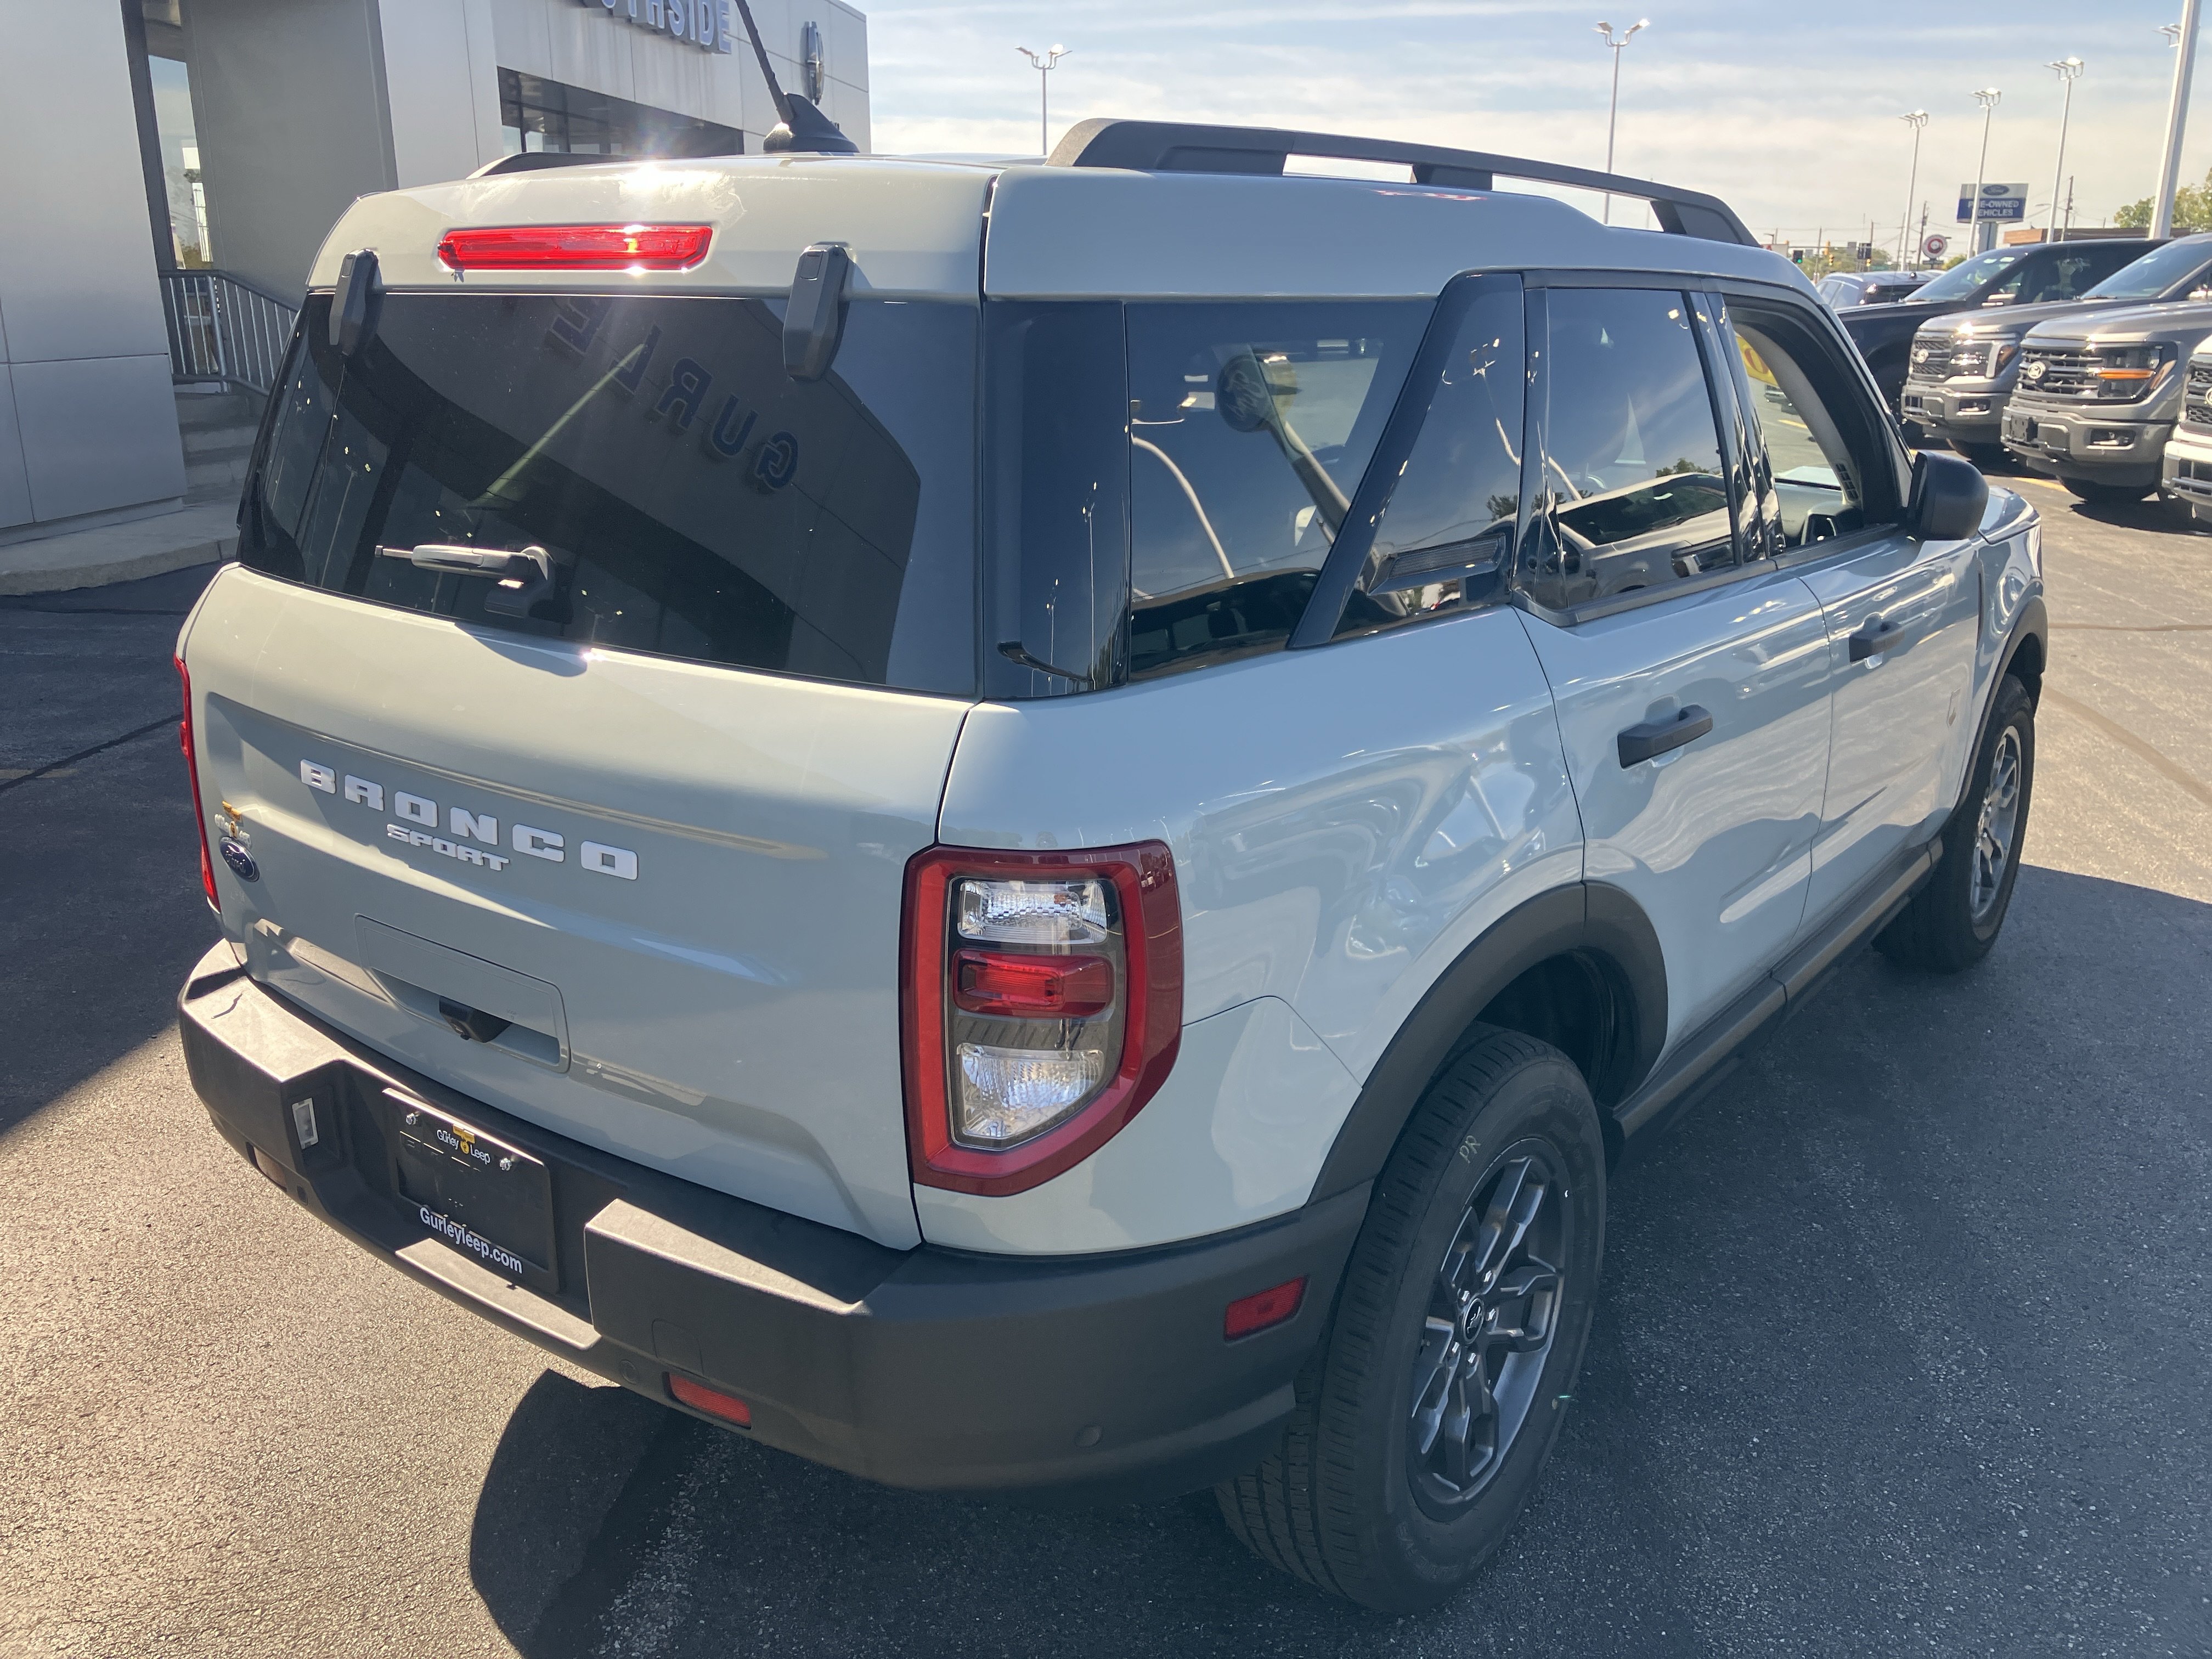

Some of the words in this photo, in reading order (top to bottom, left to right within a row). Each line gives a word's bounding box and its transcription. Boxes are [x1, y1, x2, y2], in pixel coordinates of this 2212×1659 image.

[602, 0, 732, 54] HSIDE
[1967, 200, 2019, 208] PE-OWNED
[1976, 208, 2013, 217] EHICLES
[300, 759, 639, 881] BRONCO
[386, 823, 510, 871] SPORT
[470, 1144, 491, 1165] Leep
[420, 1207, 522, 1274] Gurleyleep.com
